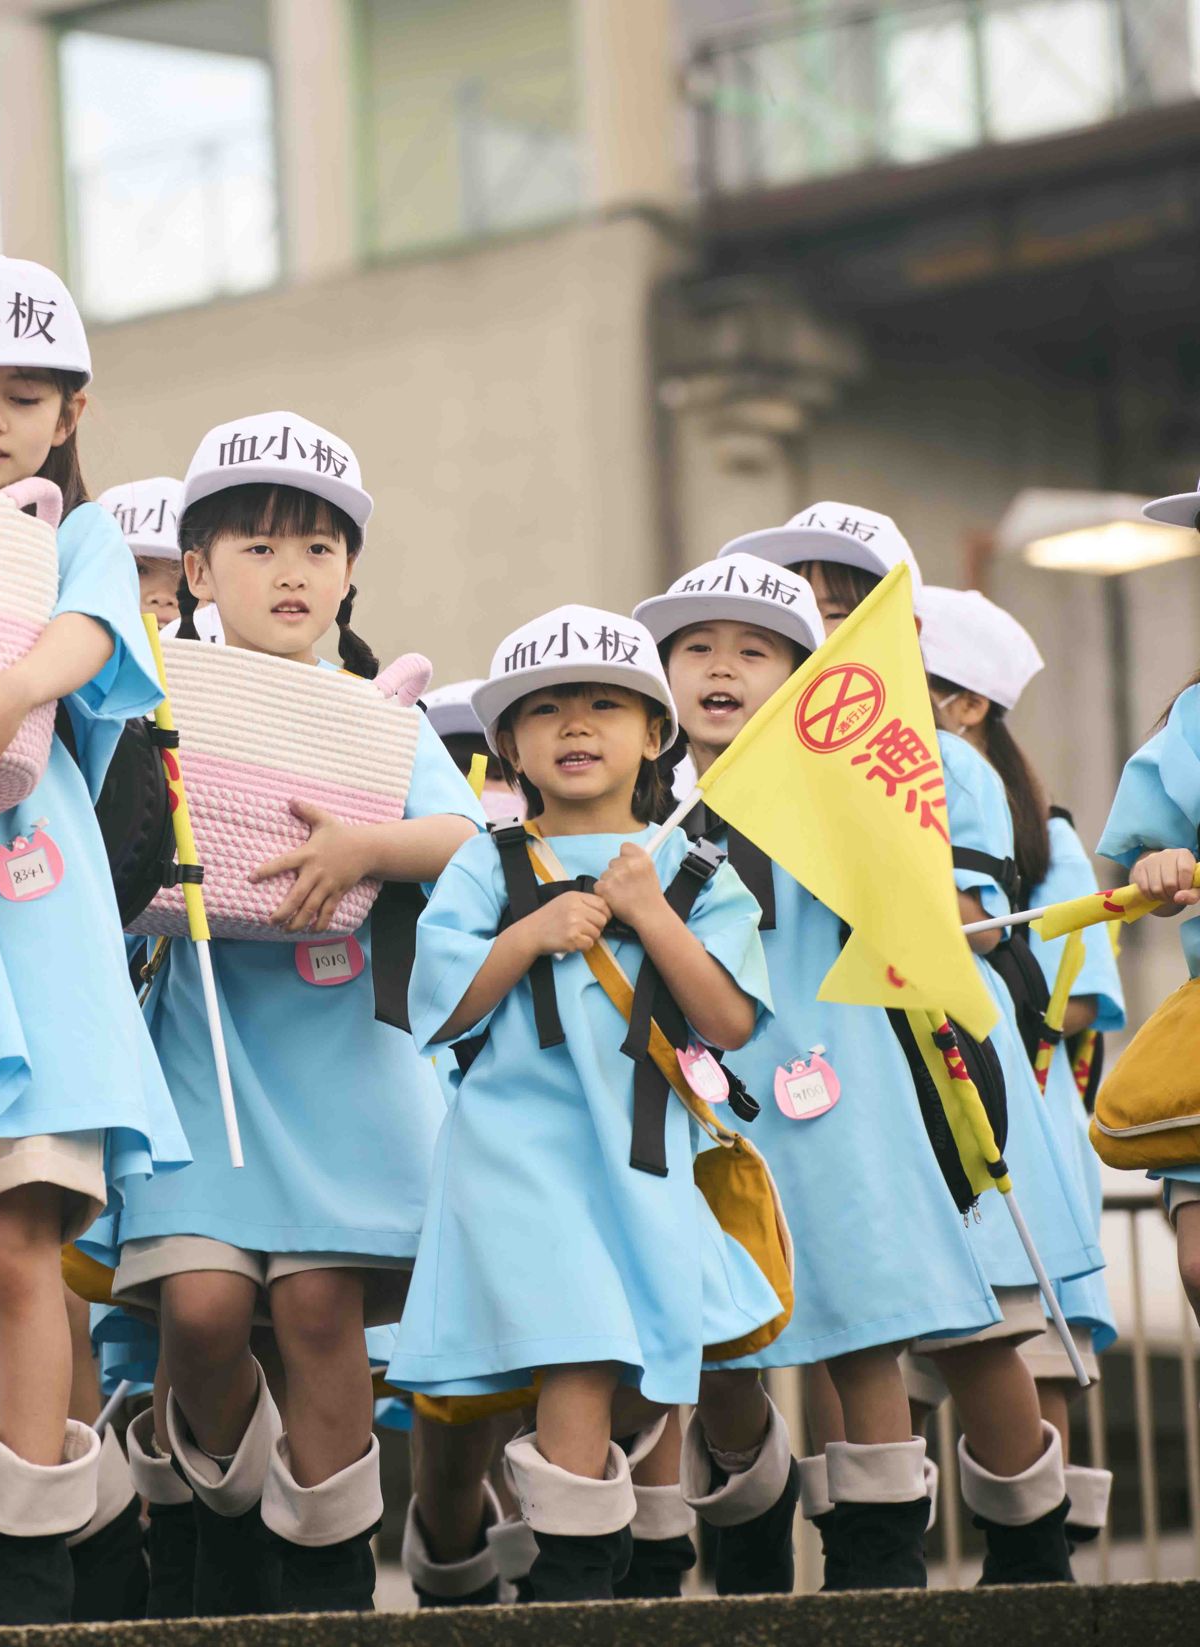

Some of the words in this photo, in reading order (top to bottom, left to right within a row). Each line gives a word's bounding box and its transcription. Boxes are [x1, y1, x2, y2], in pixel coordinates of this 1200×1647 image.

[218, 426, 349, 479] 血小板
[112, 498, 178, 536] 血小
[504, 622, 641, 673] 血小板
[12, 863, 45, 885] 8341
[314, 953, 347, 970] 1010
